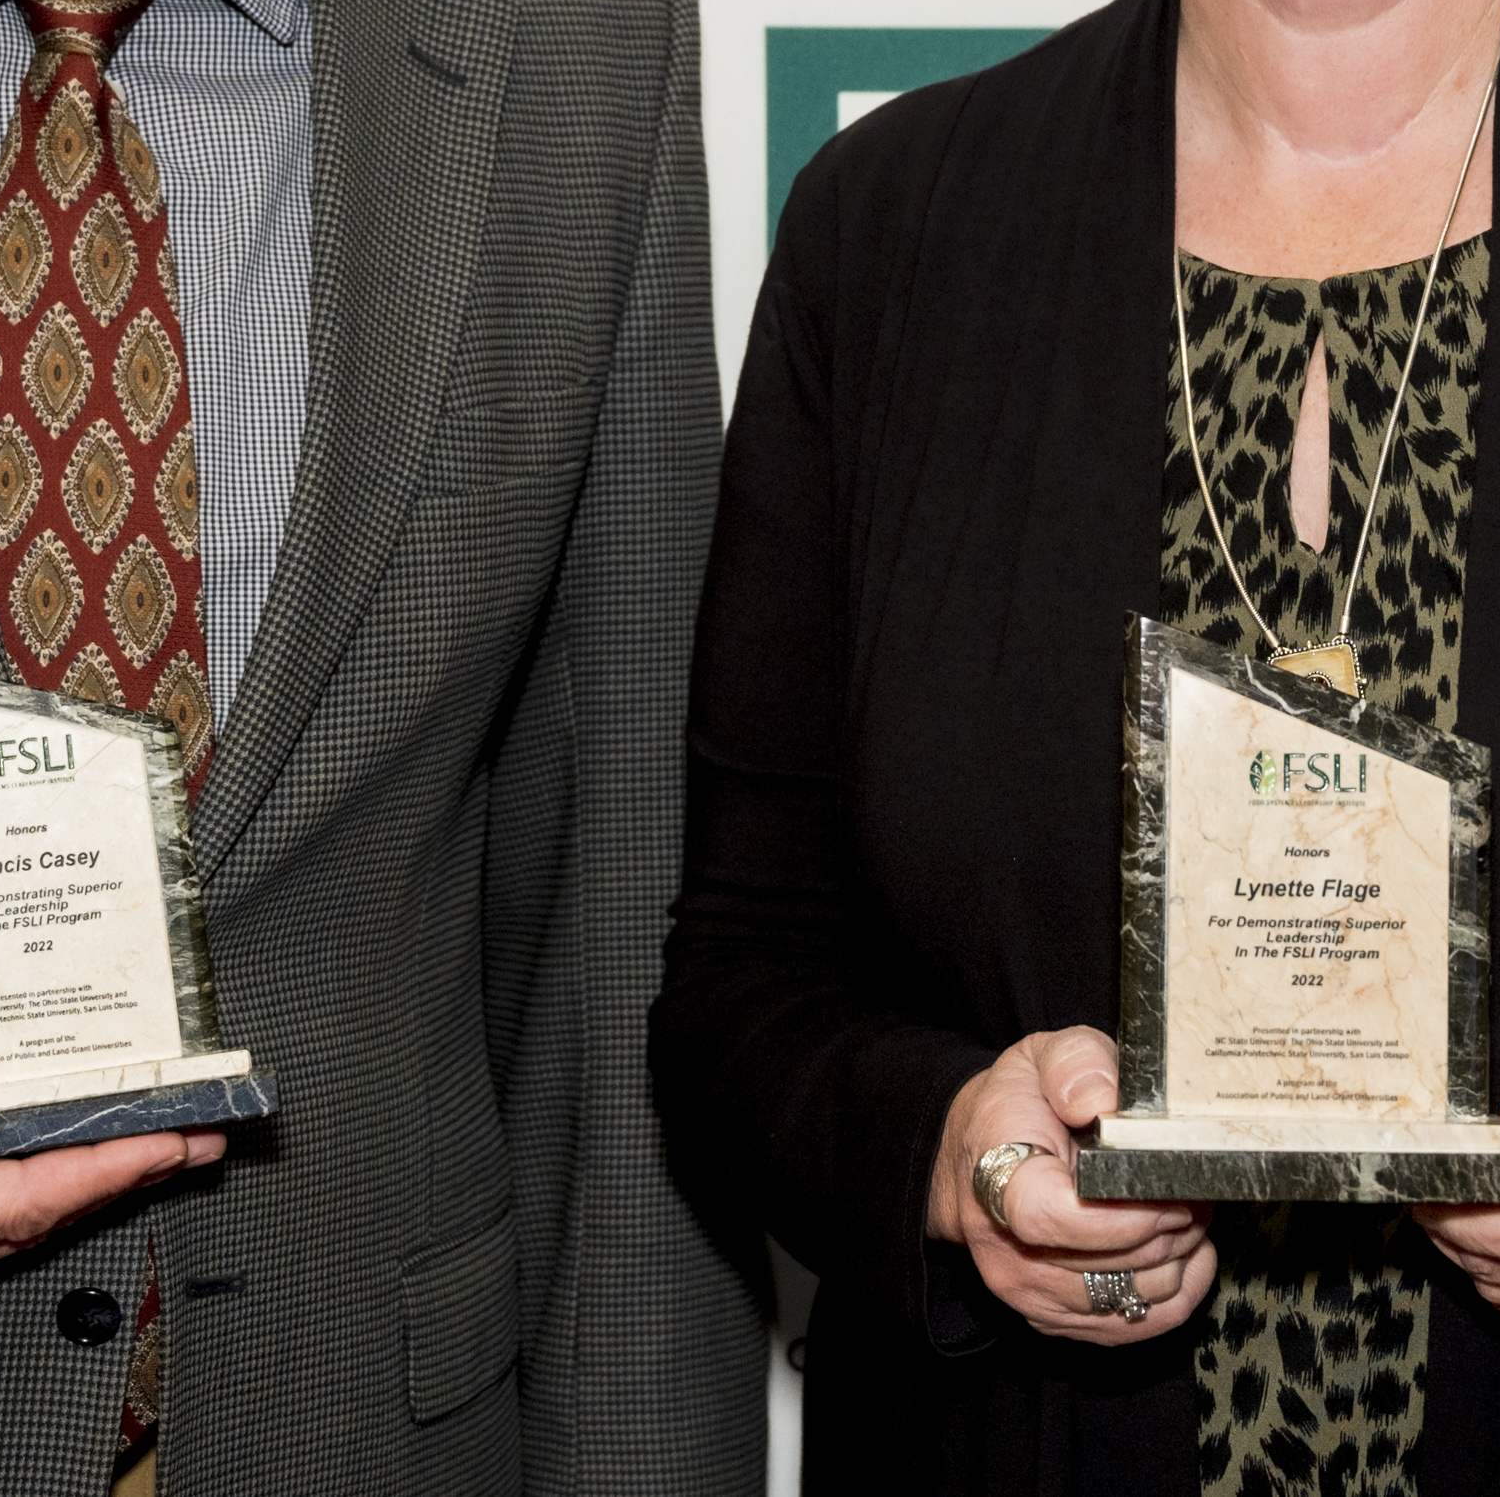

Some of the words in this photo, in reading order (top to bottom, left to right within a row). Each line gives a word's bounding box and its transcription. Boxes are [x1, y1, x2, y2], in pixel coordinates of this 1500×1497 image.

[1283, 752, 1367, 793] FSLI
[6, 823, 48, 836] Honors
[1284, 846, 1330, 858] Honors
[39, 850, 100, 869] Casey
[67, 879, 123, 896] Superior
[1235, 878, 1314, 901] Lynette
[1322, 879, 1381, 902] Flage
[13, 915, 43, 929] FSLI
[46, 909, 102, 925] Program
[1208, 915, 1233, 927] For
[1236, 916, 1340, 931] Demonstrating
[1345, 917, 1406, 932] Superior
[1266, 931, 1345, 946] Leadership
[23, 940, 54, 953] 2022
[1235, 946, 1248, 957] In
[1254, 946, 1278, 958] The
[1283, 947, 1315, 959] FSLI
[1319, 947, 1380, 962] Program
[1291, 974, 1324, 986] 2022
[37, 986, 77, 998] partnership
[78, 984, 92, 992] with
[28, 1000, 41, 1008] The
[42, 998, 58, 1007] Ohio
[60, 996, 78, 1005] State
[80, 993, 113, 1003] University
[114, 990, 128, 998] and
[27, 1011, 45, 1019] State
[84, 1005, 97, 1013] San
[98, 1003, 112, 1012] Luis
[114, 1001, 138, 1010] Obispo
[1252, 1027, 1290, 1035] Presented
[1300, 1028, 1344, 1036] partnership
[25, 1037, 54, 1047] program
[64, 1034, 76, 1042] the
[1215, 1037, 1227, 1045] NC
[1228, 1037, 1248, 1045] State
[1291, 1038, 1304, 1046] The
[1306, 1038, 1324, 1046] Ohio
[1325, 1038, 1345, 1046] State
[1346, 1039, 1383, 1048] University
[1385, 1039, 1399, 1047] and
[14, 1050, 36, 1060] Public
[37, 1049, 50, 1057] and
[92, 1040, 132, 1051] Universities
[1205, 1049, 1241, 1057] California
[1243, 1049, 1286, 1058] Polytechnic
[1287, 1050, 1308, 1058] State
[1350, 1051, 1364, 1059] San
[1366, 1050, 1381, 1059] Luis
[1383, 1051, 1409, 1060] Obispo
[1283, 1080, 1315, 1088] program
[1216, 1091, 1259, 1100] Association
[1270, 1092, 1294, 1100] Public
[1295, 1092, 1309, 1101] and
[1354, 1093, 1398, 1102] Universities
